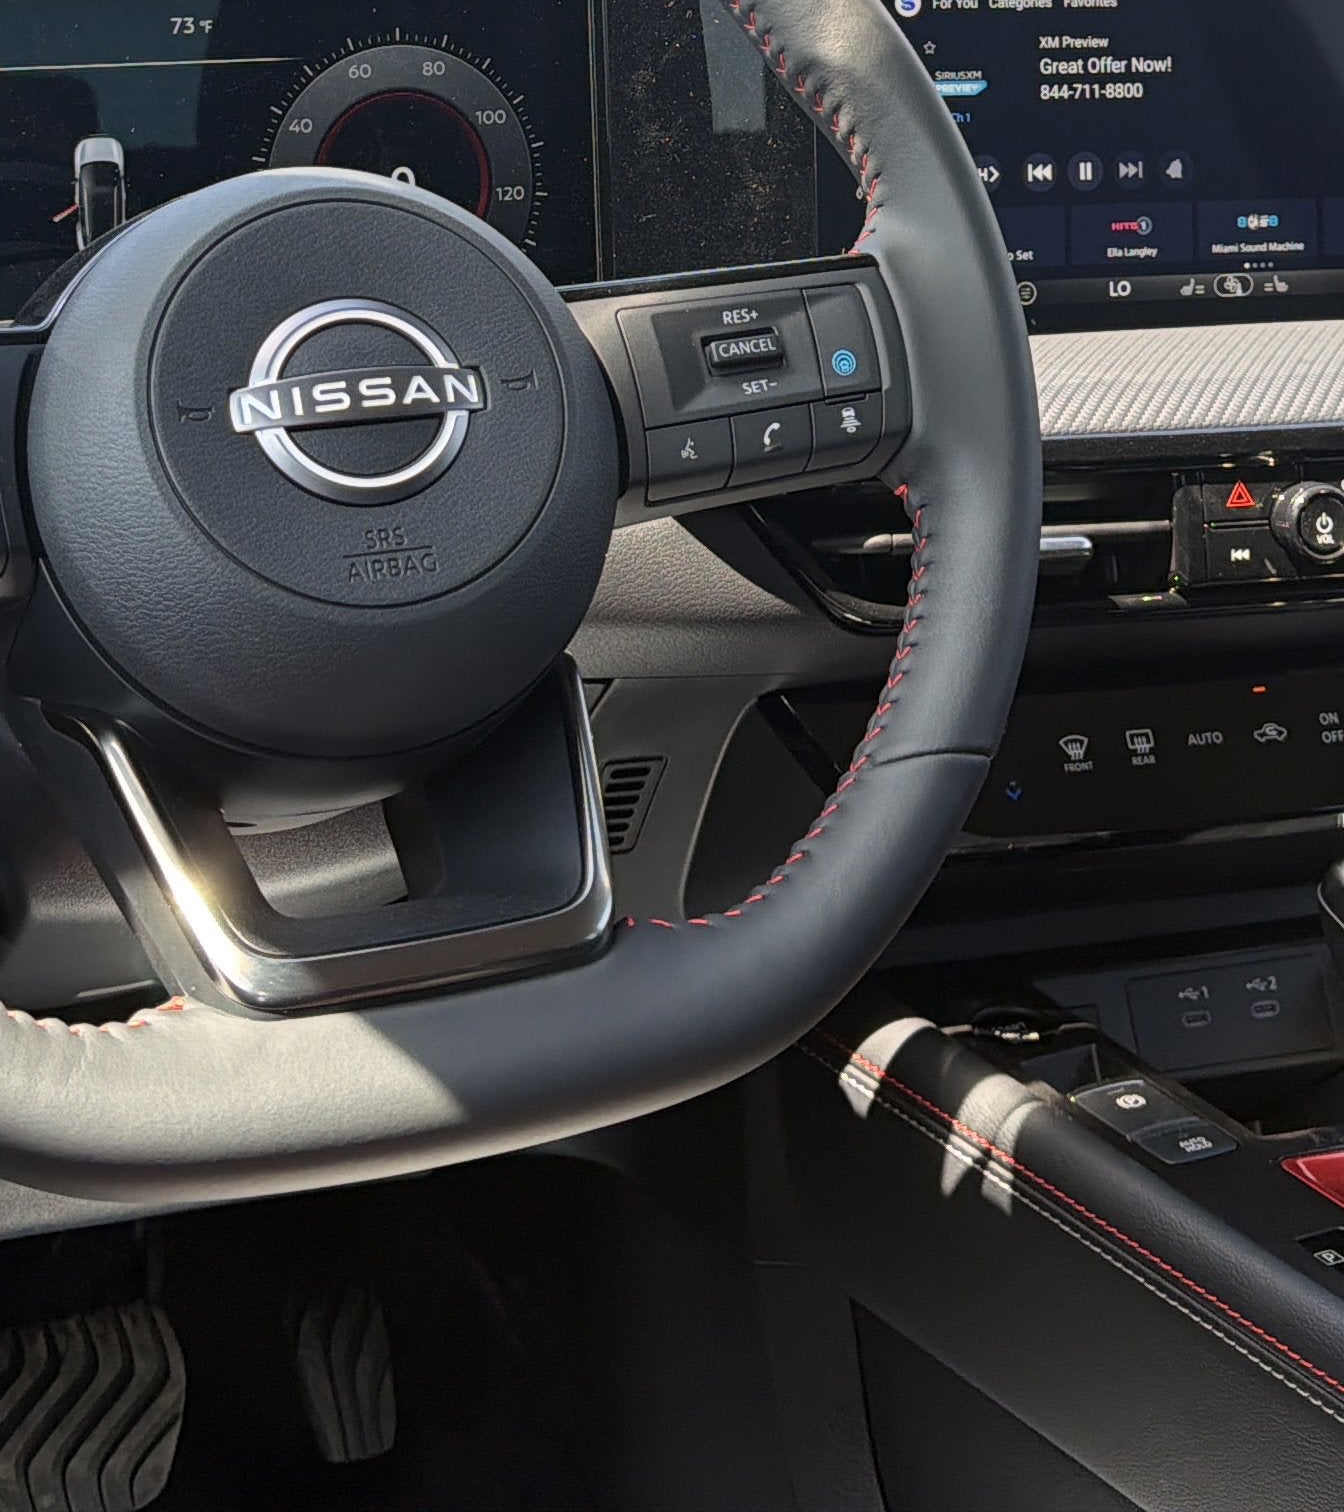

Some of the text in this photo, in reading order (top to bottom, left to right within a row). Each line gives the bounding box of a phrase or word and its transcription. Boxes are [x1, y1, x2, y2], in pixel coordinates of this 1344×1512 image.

[170, 17, 195, 35] 73
[1039, 35, 1109, 49] XM Preview
[348, 63, 372, 79] 60
[422, 60, 446, 76] 80
[1039, 55, 1172, 75] Great Offer Now!
[934, 70, 982, 80] SIRIUSXM
[1040, 82, 1144, 100] 844-711-8800
[475, 109, 507, 125] 100
[965, 112, 971, 122] 1
[289, 118, 313, 135] 40
[496, 186, 525, 202] 120
[1016, 249, 1035, 260] Set
[1211, 241, 1305, 253] Miami Sound Machine
[1109, 280, 1132, 297] LO
[722, 308, 759, 325] RES+
[718, 338, 777, 358] CANCEL
[240, 374, 480, 425] NISSAN
[364, 526, 407, 550] SRS
[1316, 534, 1335, 545] VOL
[347, 552, 440, 584] AIRBAG
[1319, 712, 1339, 725] ON
[1187, 731, 1224, 746] AUTO
[1321, 729, 1344, 743] OFF
[1064, 761, 1093, 772] FRONT
[1131, 754, 1156, 766] REAR
[1267, 976, 1278, 990] 2
[1200, 985, 1210, 999] 1
